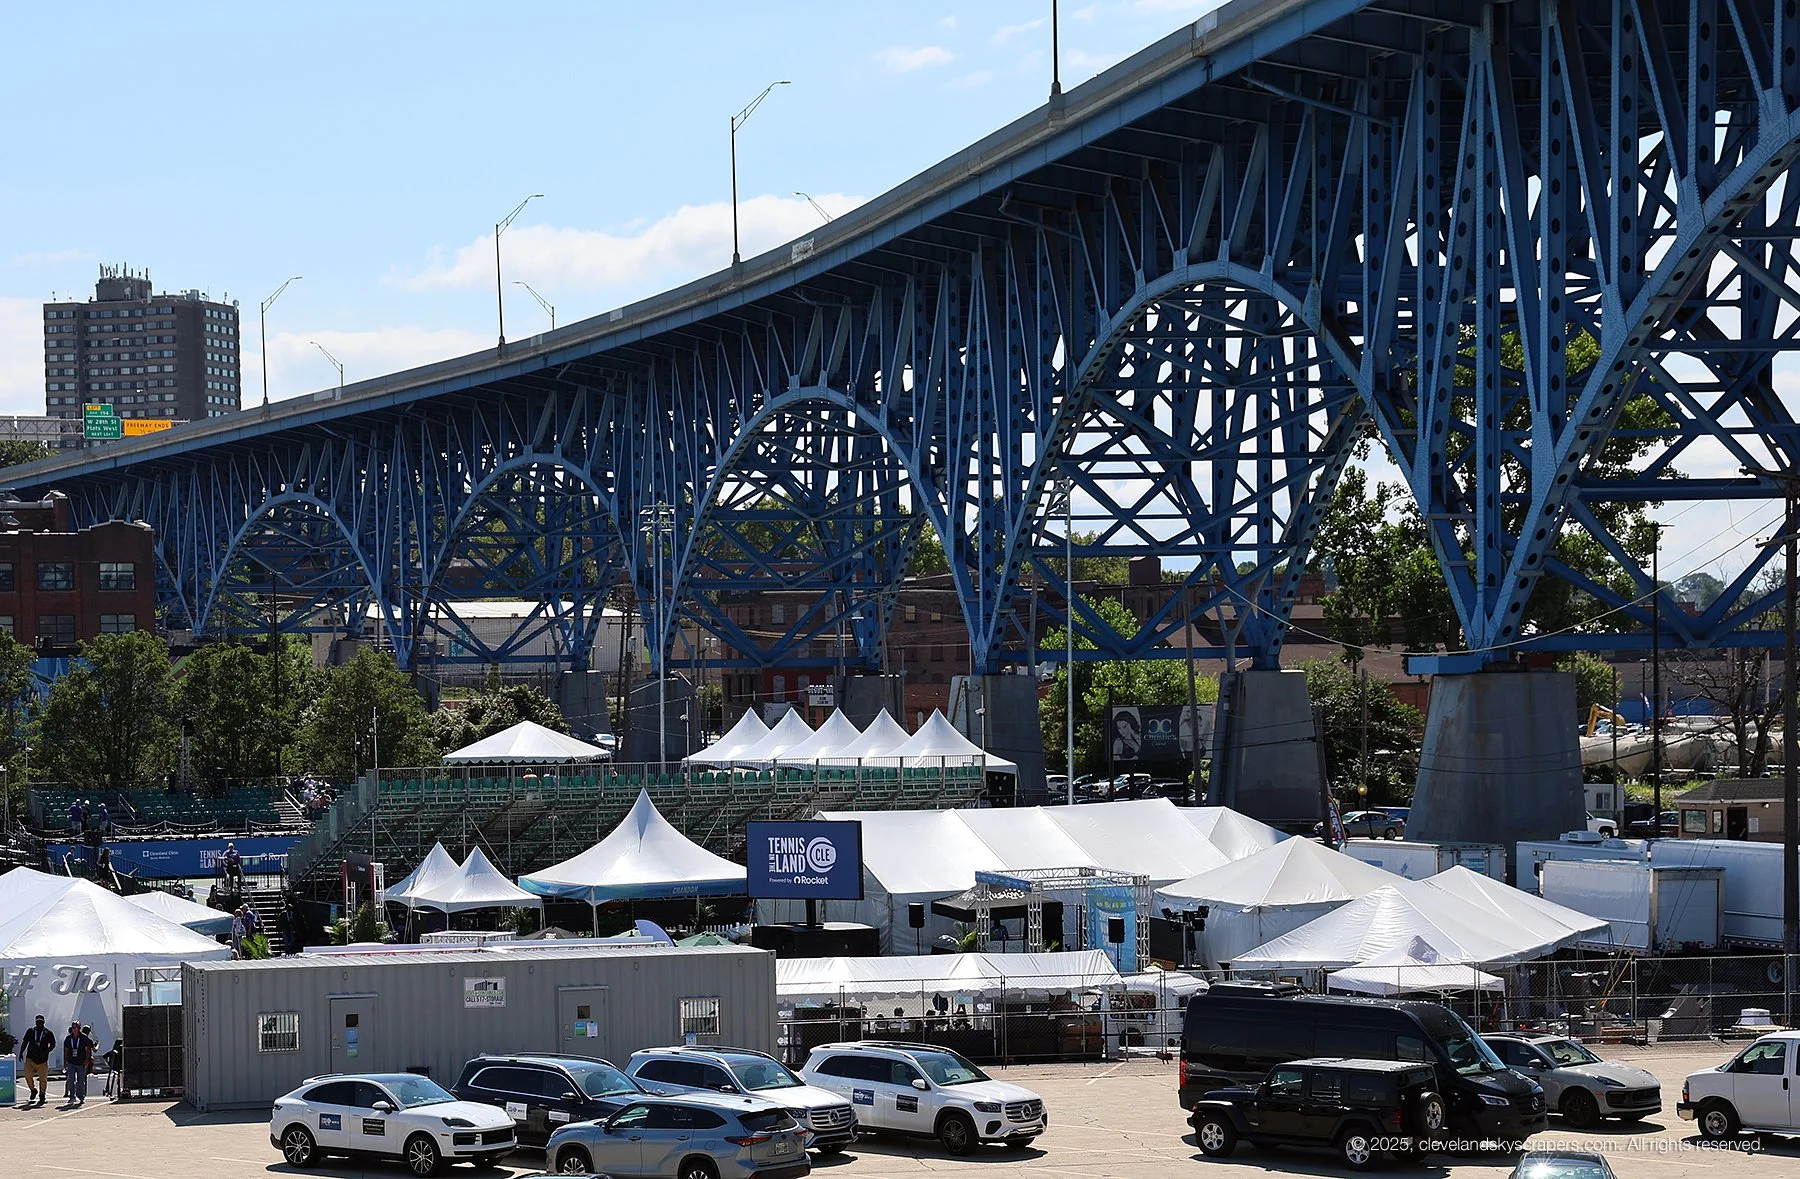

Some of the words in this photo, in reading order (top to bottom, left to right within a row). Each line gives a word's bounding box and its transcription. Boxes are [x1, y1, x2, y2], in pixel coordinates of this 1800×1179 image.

[768, 837, 805, 854] TENNIS
[200, 849, 221, 859] TENNIS
[815, 848, 830, 862] CLE
[776, 854, 806, 873] LAND
[801, 875, 829, 885] Rocket
[672, 886, 699, 895] CHANDON
[50, 964, 111, 996] The
